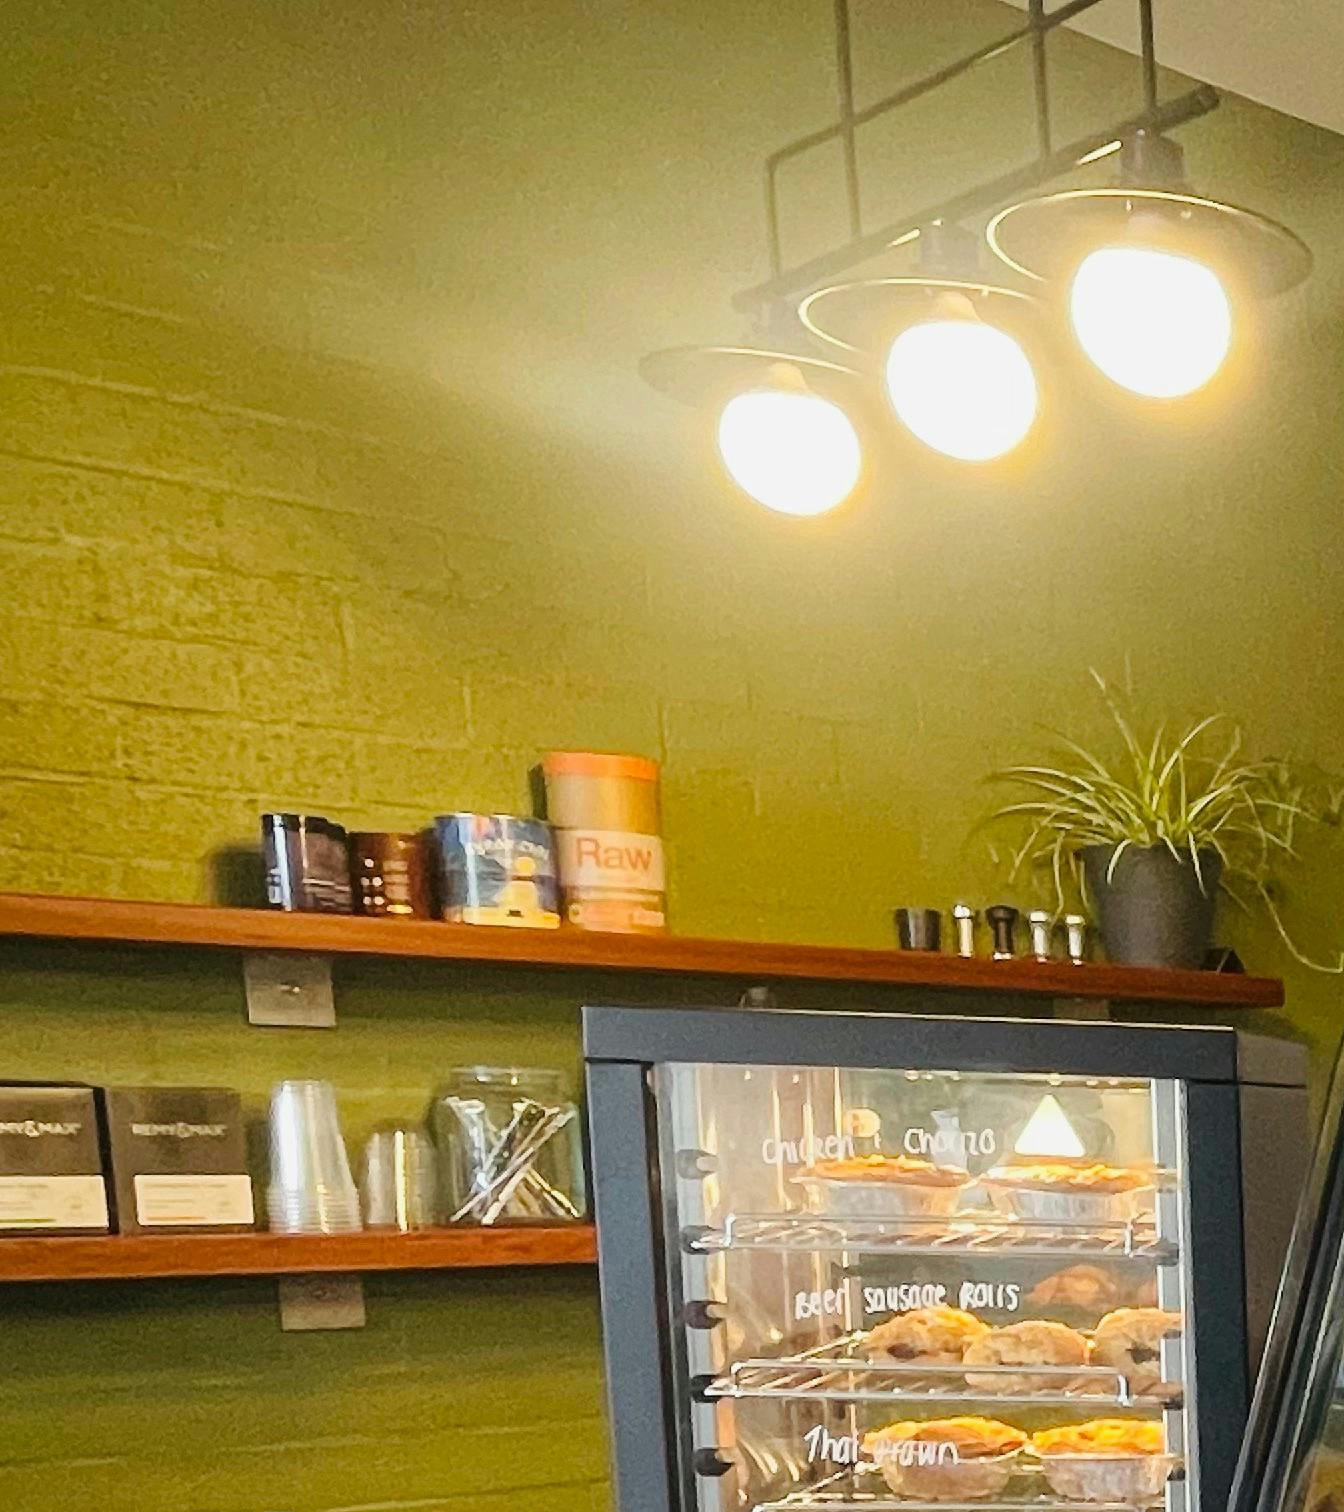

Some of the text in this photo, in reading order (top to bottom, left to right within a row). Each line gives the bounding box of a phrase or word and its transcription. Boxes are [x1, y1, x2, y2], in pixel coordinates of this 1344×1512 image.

[575, 837, 653, 872] Raw
[762, 1133, 855, 1166] Chicken
[804, 1424, 858, 1465] Thai
